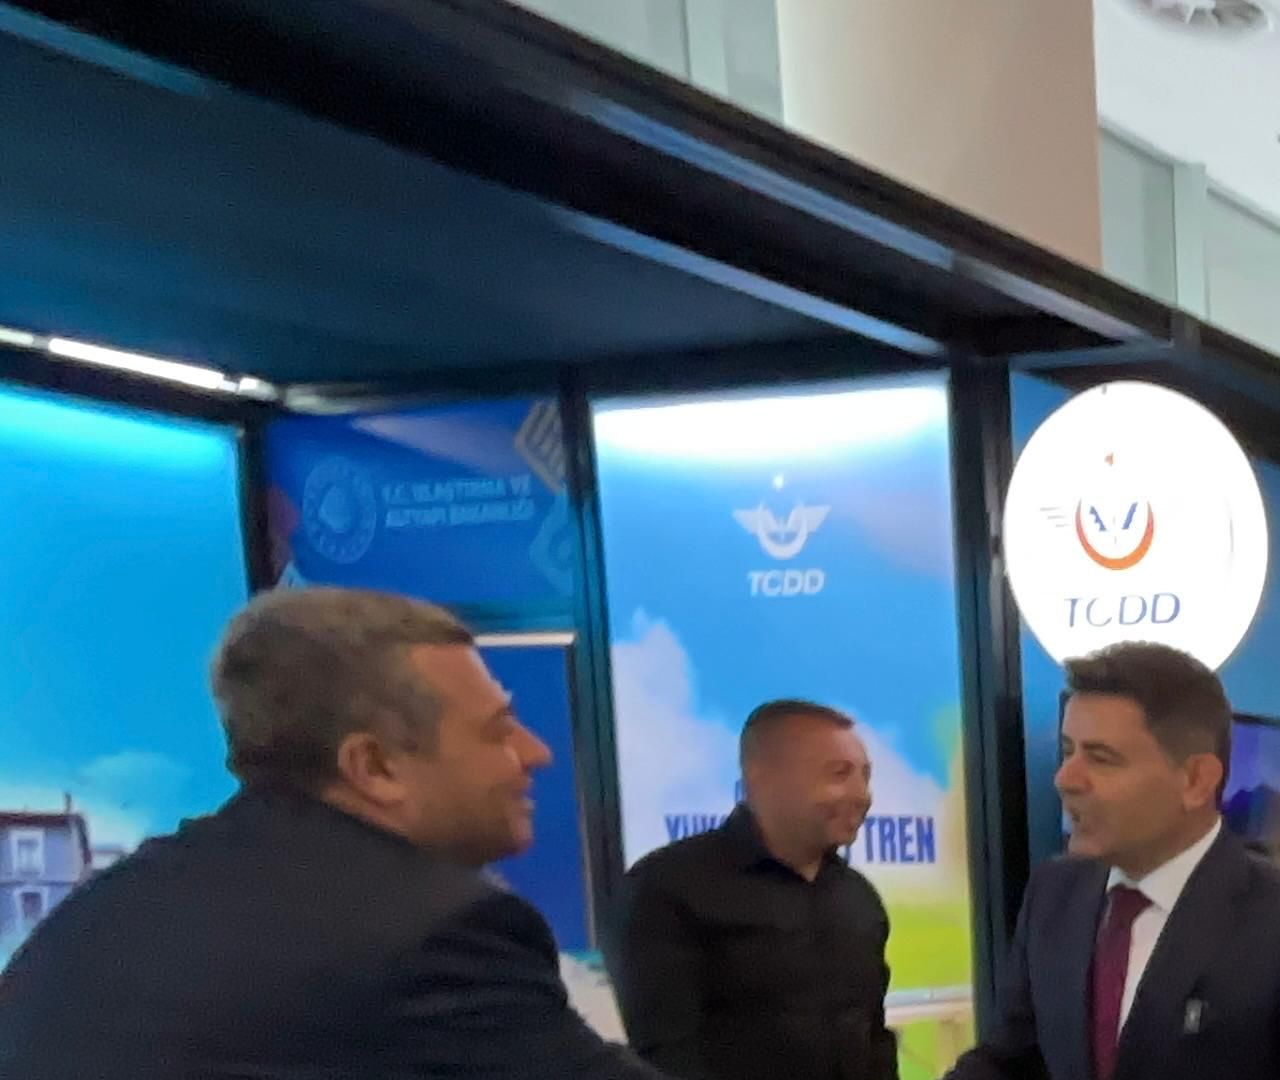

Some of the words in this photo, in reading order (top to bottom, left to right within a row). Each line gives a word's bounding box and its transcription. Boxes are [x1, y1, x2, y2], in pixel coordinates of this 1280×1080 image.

[747, 568, 826, 597] TCDD
[1063, 591, 1182, 629] TCDD
[864, 815, 937, 863] TREN
